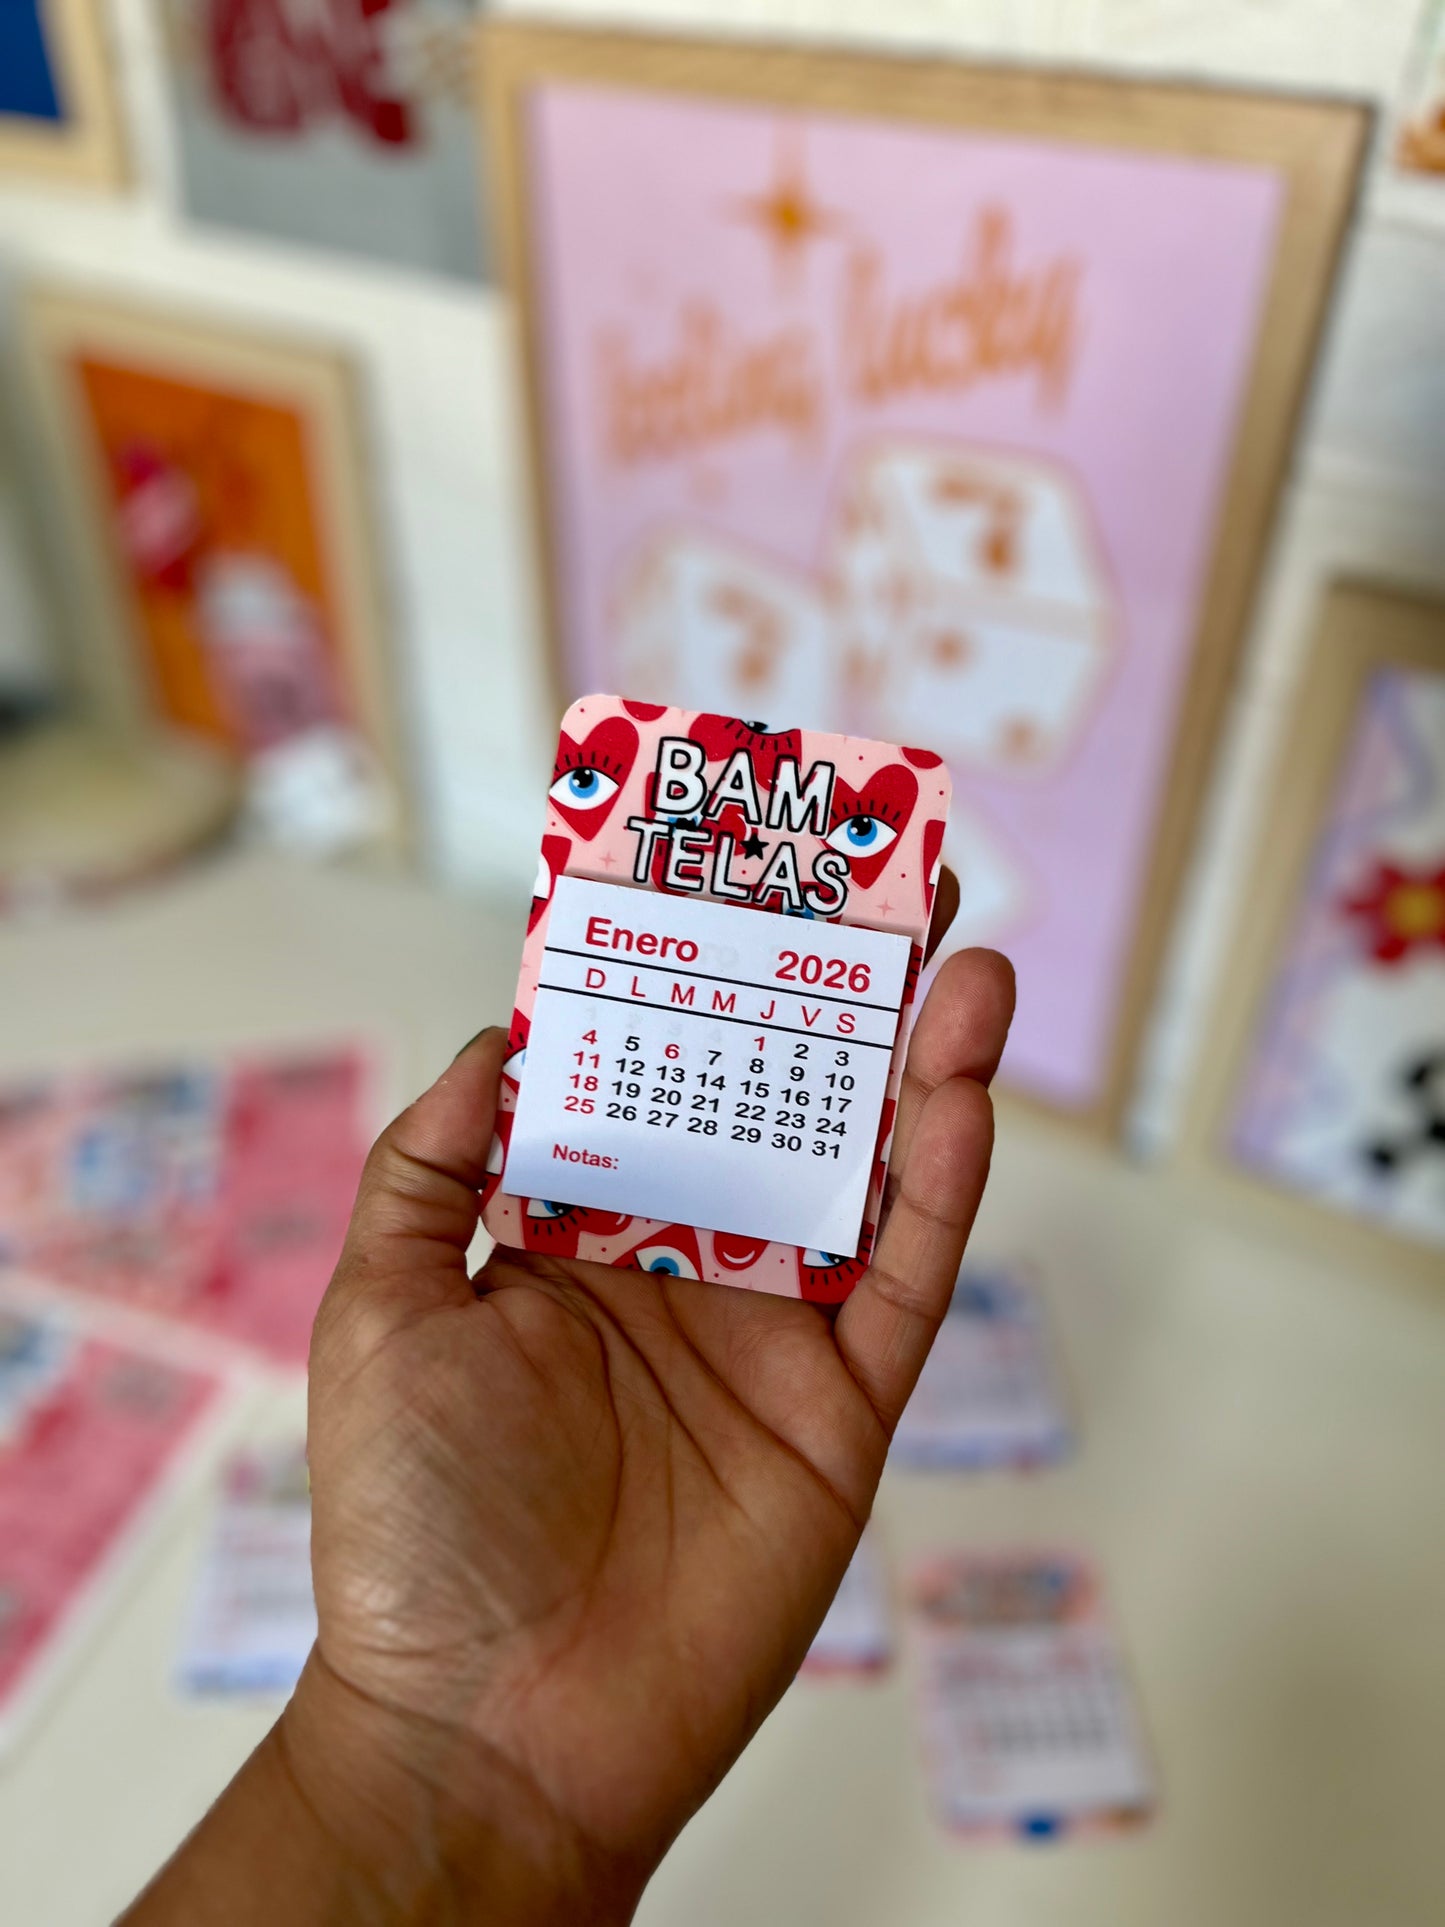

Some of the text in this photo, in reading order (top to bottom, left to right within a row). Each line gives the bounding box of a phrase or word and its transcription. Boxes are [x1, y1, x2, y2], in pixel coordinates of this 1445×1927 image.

[651, 737, 837, 838] BAM
[628, 816, 851, 915] TELAS
[585, 916, 699, 962] Enero
[775, 950, 872, 993] 2026
[585, 968, 856, 1034] D L M M J V S
[573, 1051, 852, 1113] 11 12 13 14 15 16 17
[582, 1029, 855, 1091] 4 5 6 7 8 9 10
[754, 1036, 849, 1067] 1 2 3
[564, 1096, 840, 1159] 25 26 27 28 29 30 31
[569, 1073, 847, 1137] 18 19 20 21 22 23 24
[553, 1144, 619, 1170] Notas:
